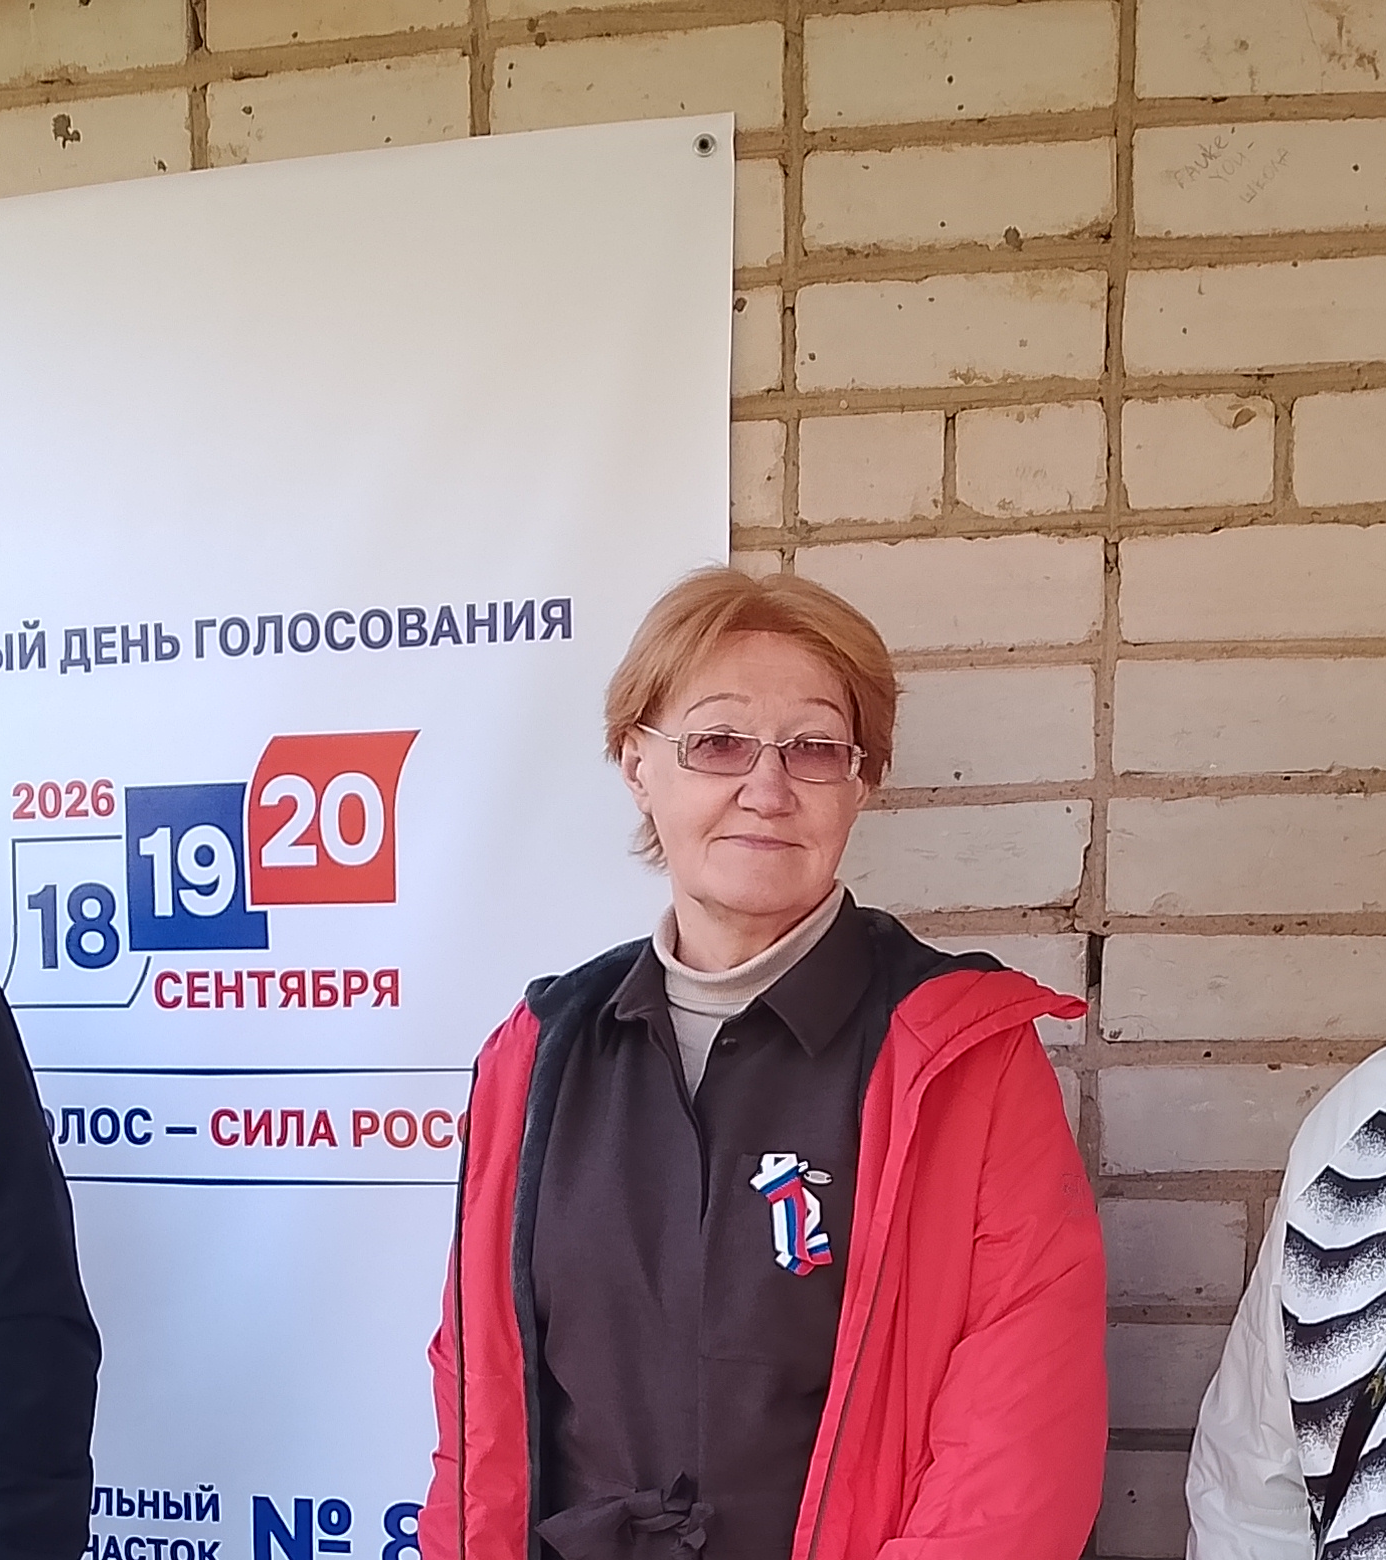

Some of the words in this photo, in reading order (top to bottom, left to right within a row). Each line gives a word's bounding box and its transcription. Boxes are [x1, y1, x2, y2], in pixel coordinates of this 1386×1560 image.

[60, 622, 181, 675] ДЕНЬ
[194, 597, 573, 659] ГОЛОСОВАНИЯ
[12, 779, 115, 820] 2026
[27, 882, 120, 969] 18
[139, 824, 237, 918] 19
[259, 771, 386, 868] 20
[153, 967, 401, 1009] СЕНТЯБРЯ
[210, 1108, 339, 1147] СИЛА
[352, 1108, 467, 1149] РОС
